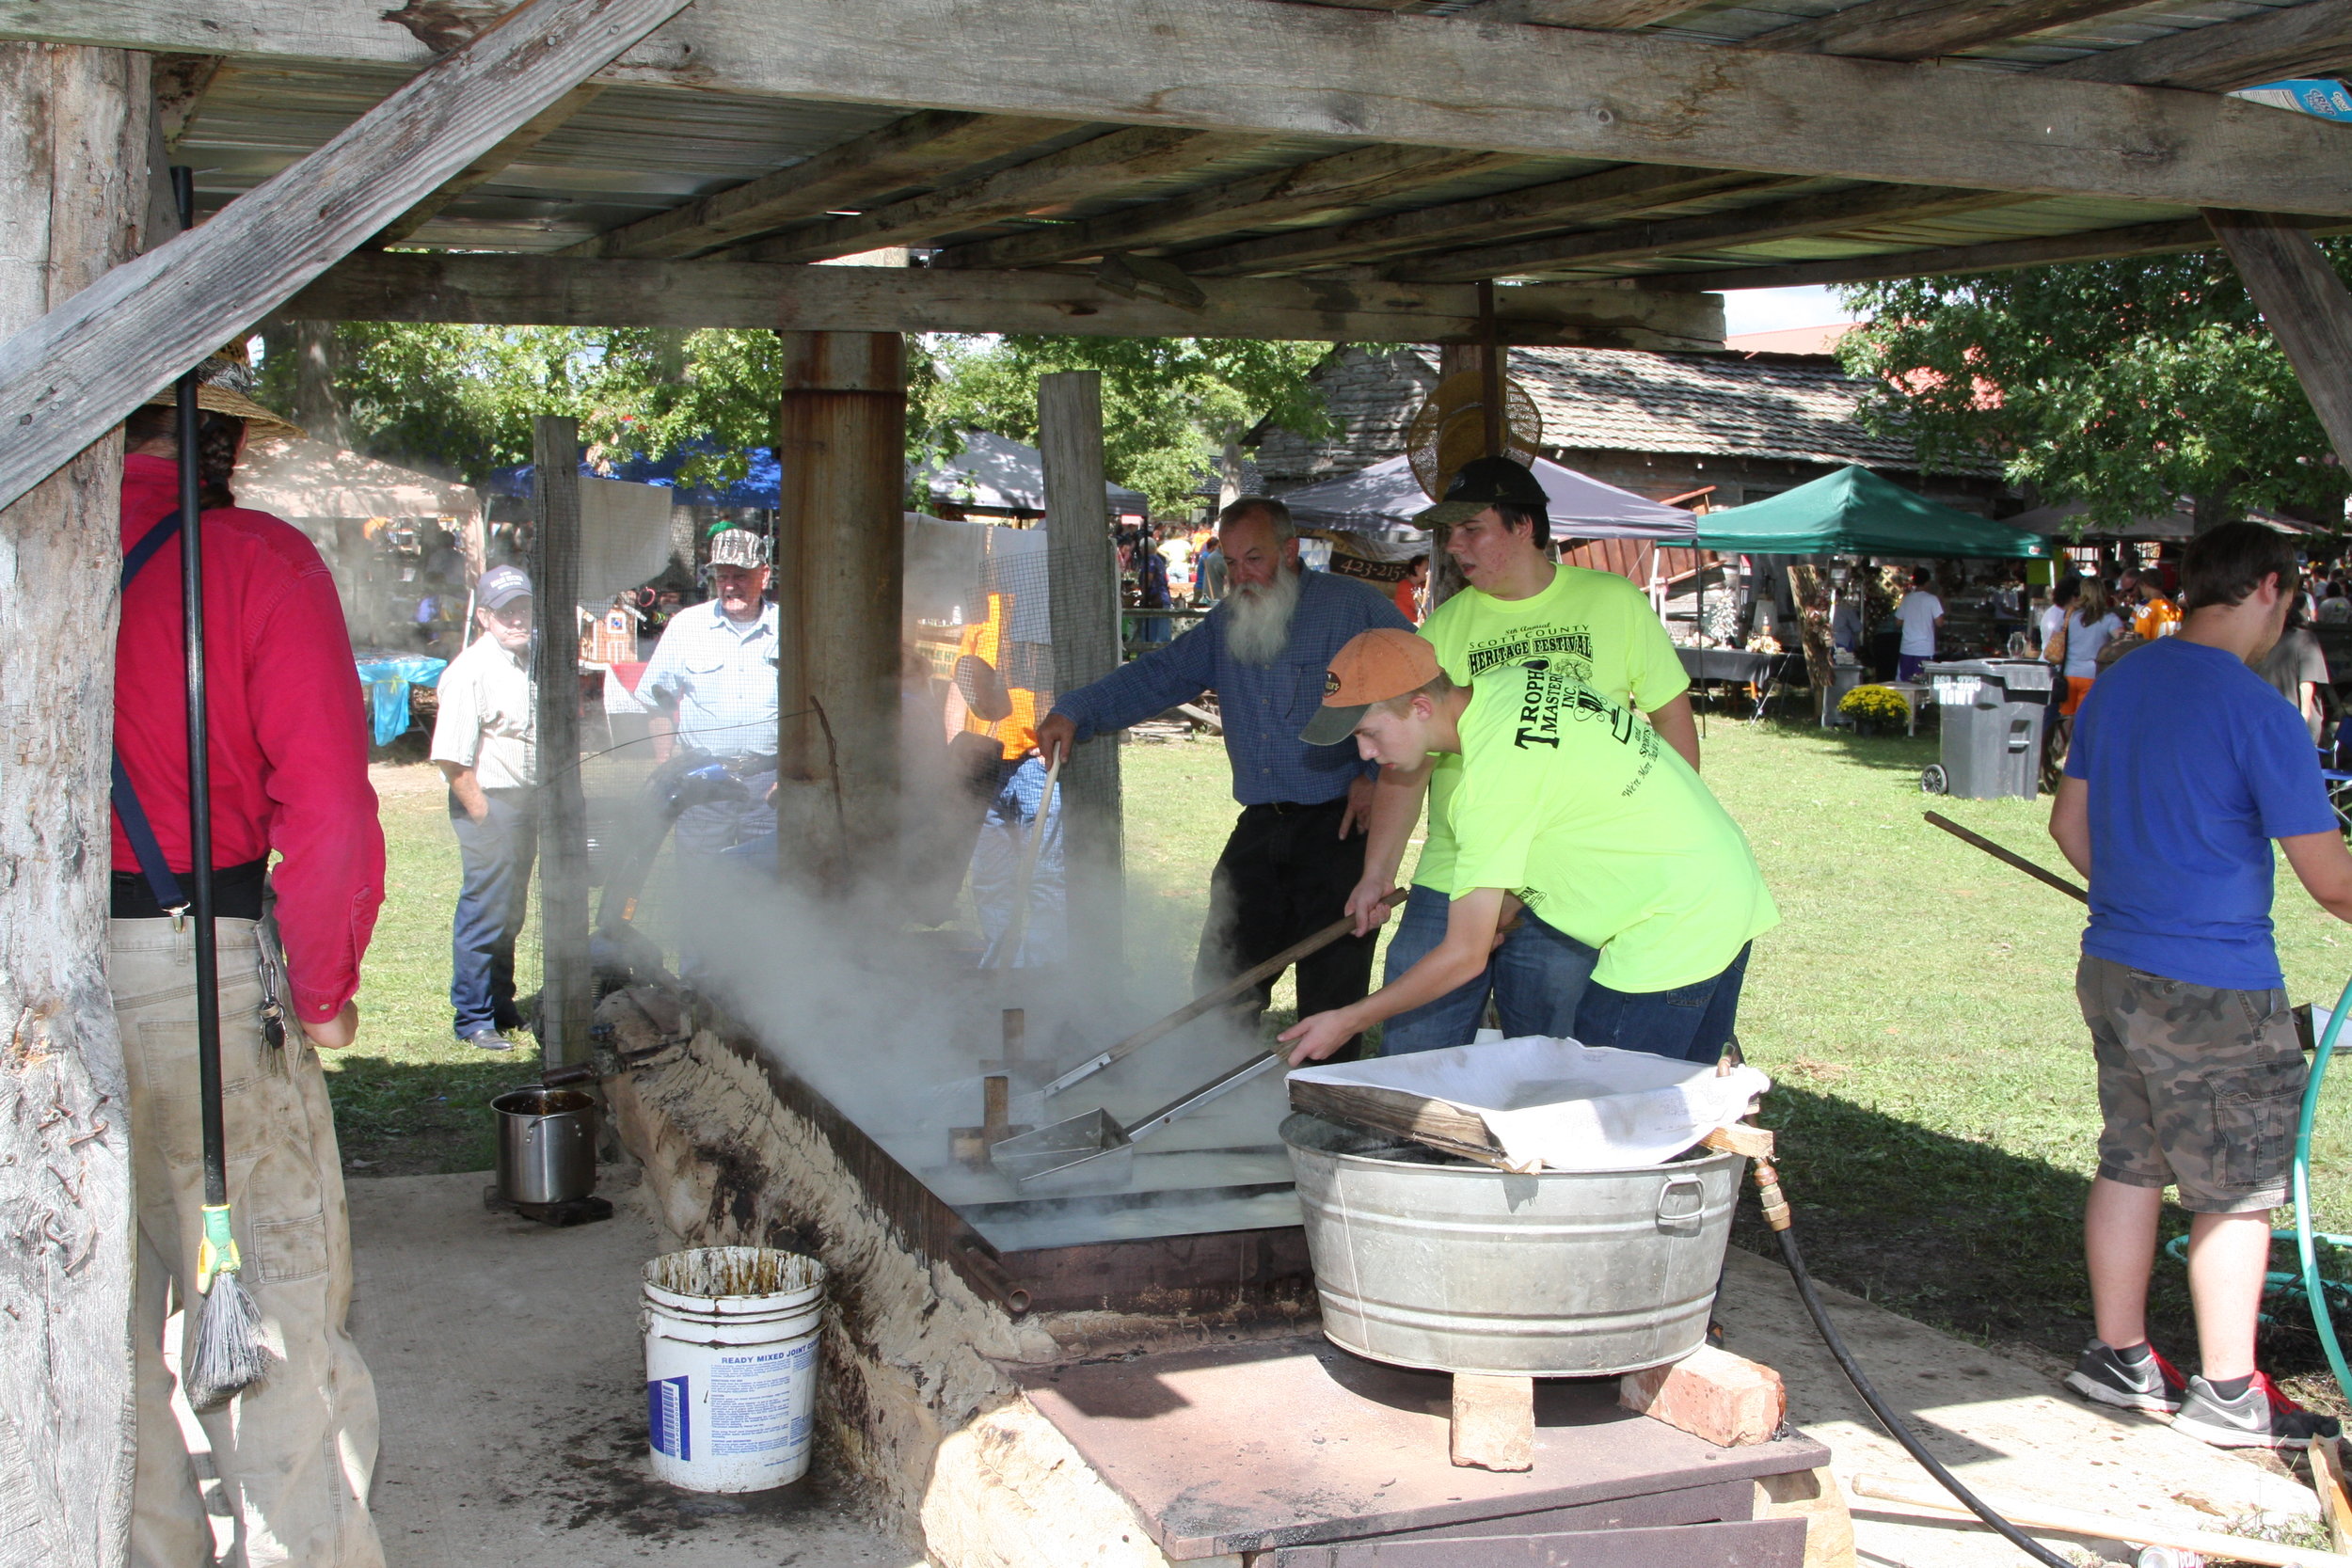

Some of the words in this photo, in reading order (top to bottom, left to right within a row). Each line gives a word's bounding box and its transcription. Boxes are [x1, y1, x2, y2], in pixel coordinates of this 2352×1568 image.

[1470, 635, 1517, 649] SCOTT
[1525, 625, 1589, 639] COUNTY
[1519, 621, 1551, 632] Annual
[1469, 641, 1530, 675] HERITAGE
[1534, 635, 1593, 658] FESTIVAL
[1562, 686, 1577, 709] INC.
[756, 1353, 785, 1362] MIXED
[787, 1345, 806, 1357] JOINT
